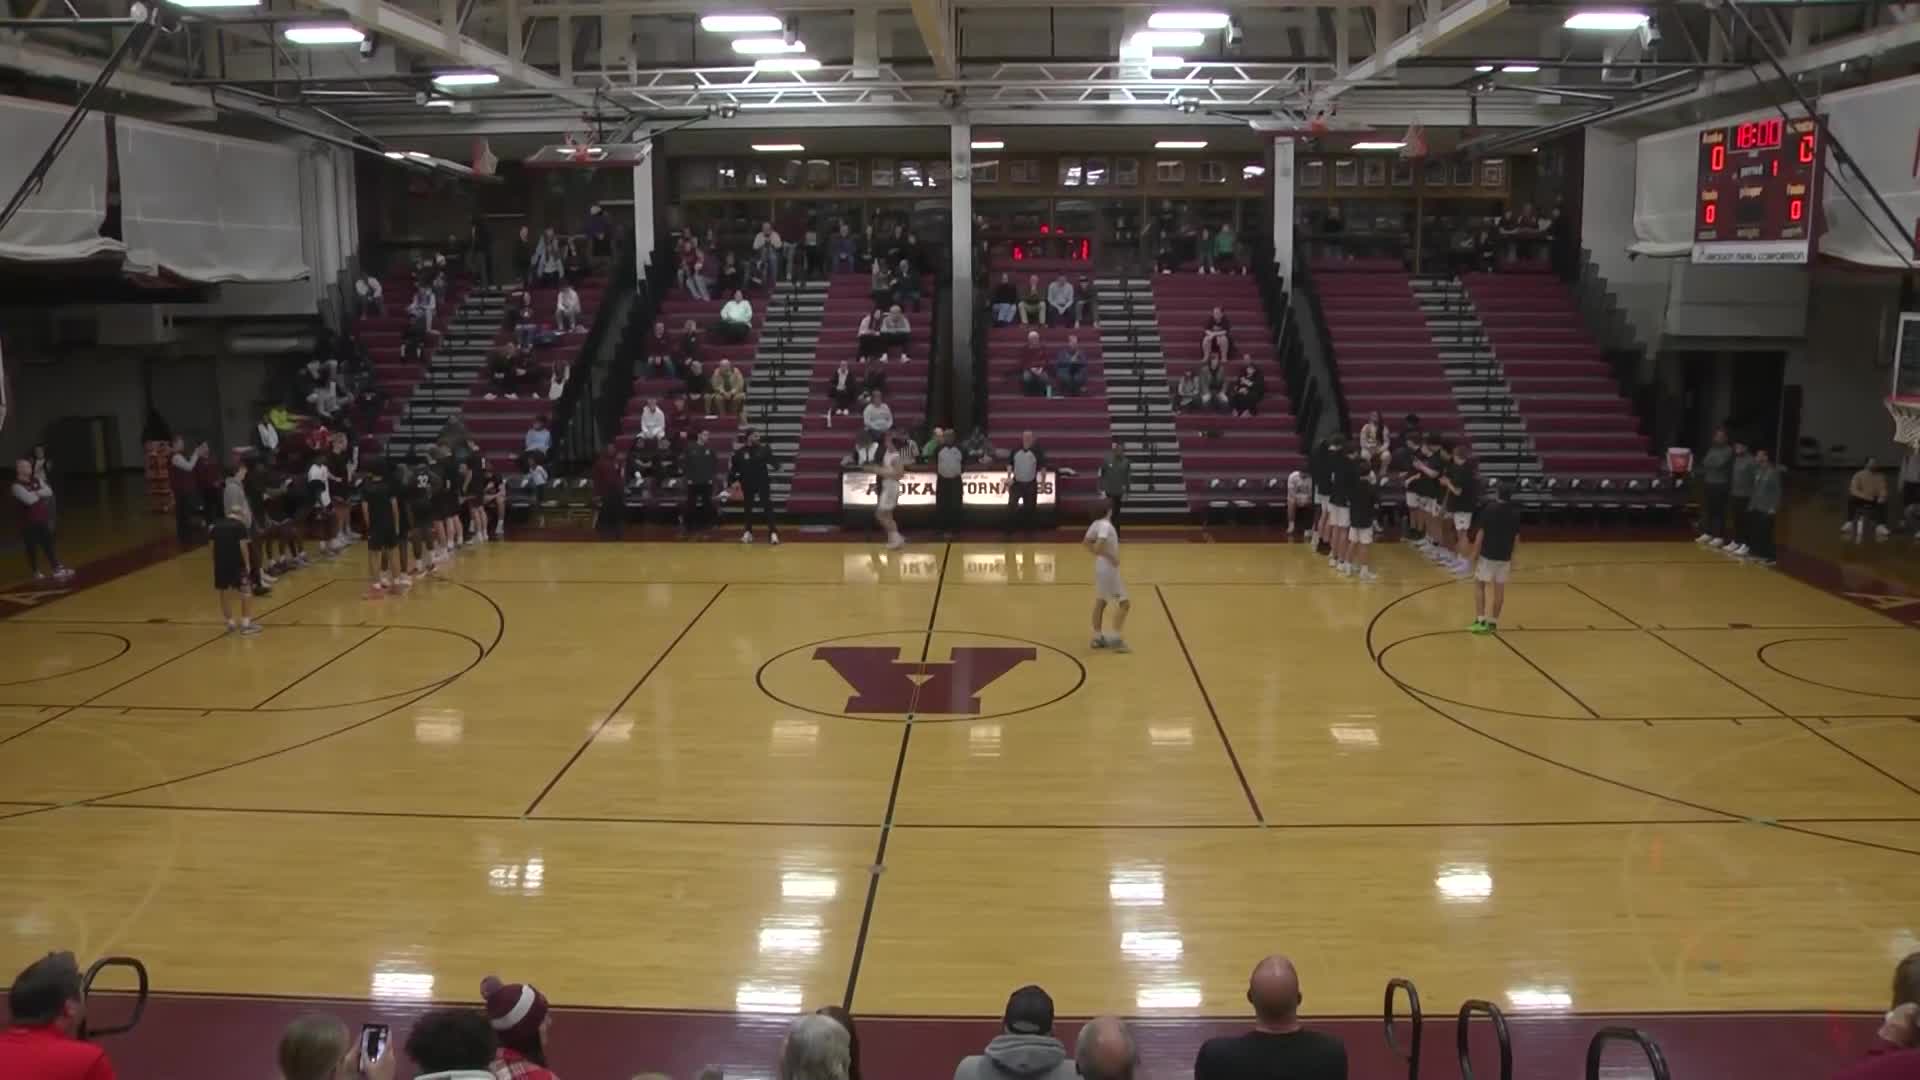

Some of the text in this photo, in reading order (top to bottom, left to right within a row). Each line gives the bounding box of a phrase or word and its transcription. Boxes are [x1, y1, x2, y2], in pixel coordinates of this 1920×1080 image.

[1736, 119, 1781, 148] 18:00
[1711, 145, 1724, 171] 0
[1772, 159, 1780, 177] 1
[1705, 204, 1716, 223] 0
[1791, 200, 1801, 220] 0
